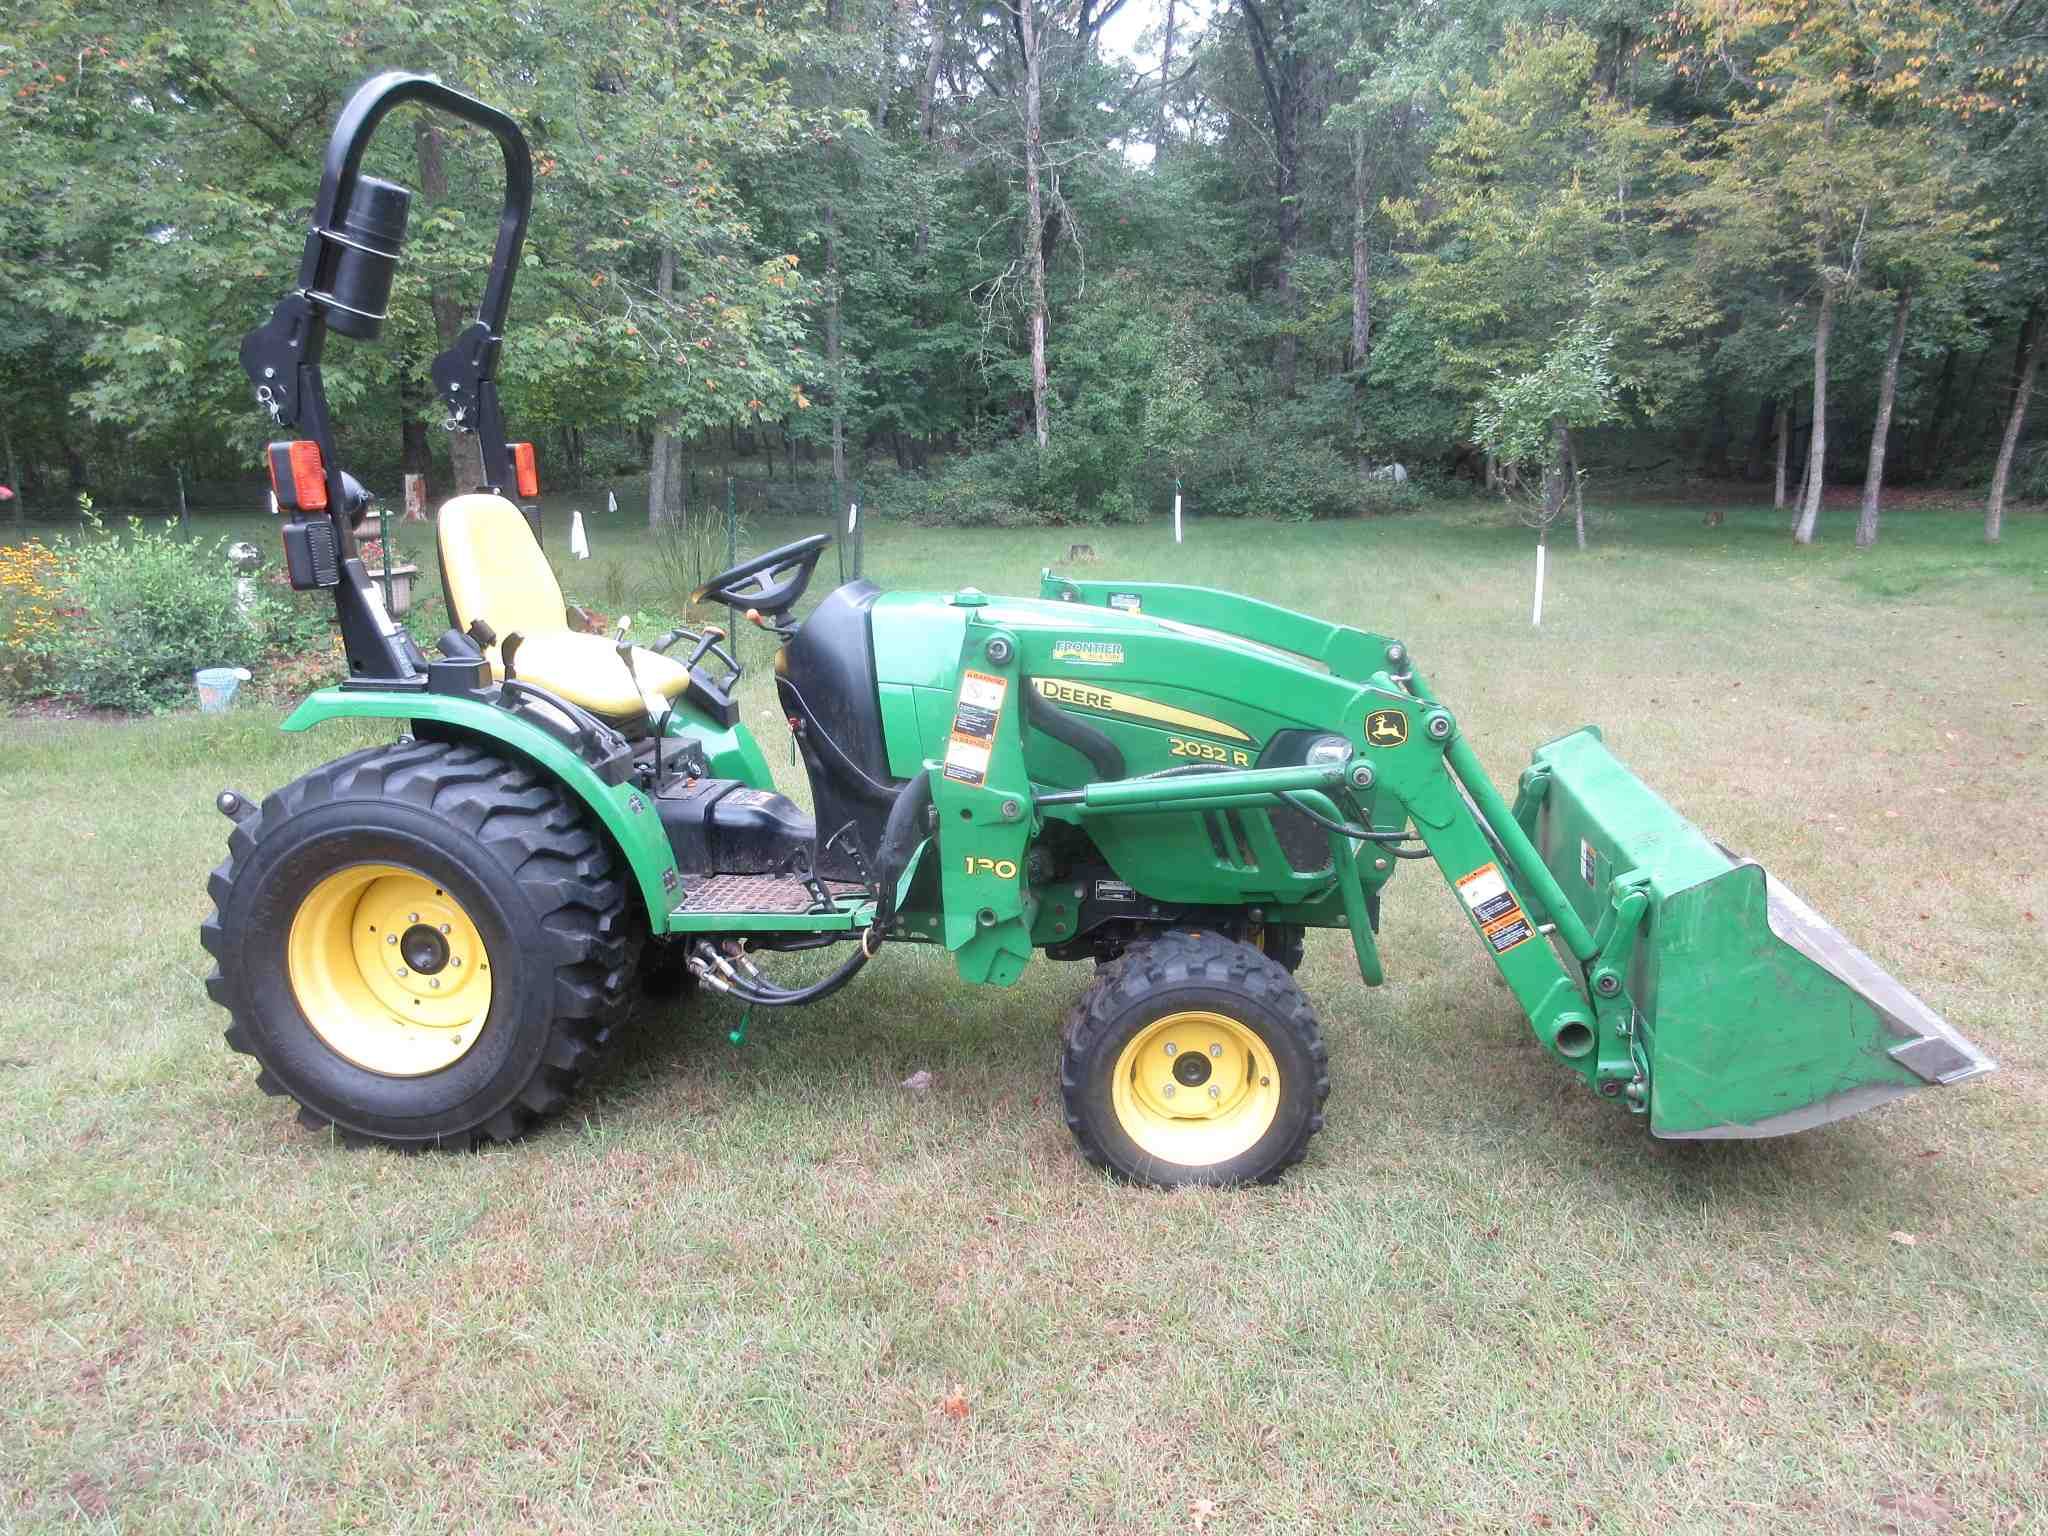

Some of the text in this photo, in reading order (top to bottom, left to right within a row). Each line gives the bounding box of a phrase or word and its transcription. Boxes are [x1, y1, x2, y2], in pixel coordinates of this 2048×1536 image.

[1055, 640, 1122, 654] FRONTIER
[1043, 681, 1113, 708] DEERE
[1168, 738, 1249, 767] 2032 R
